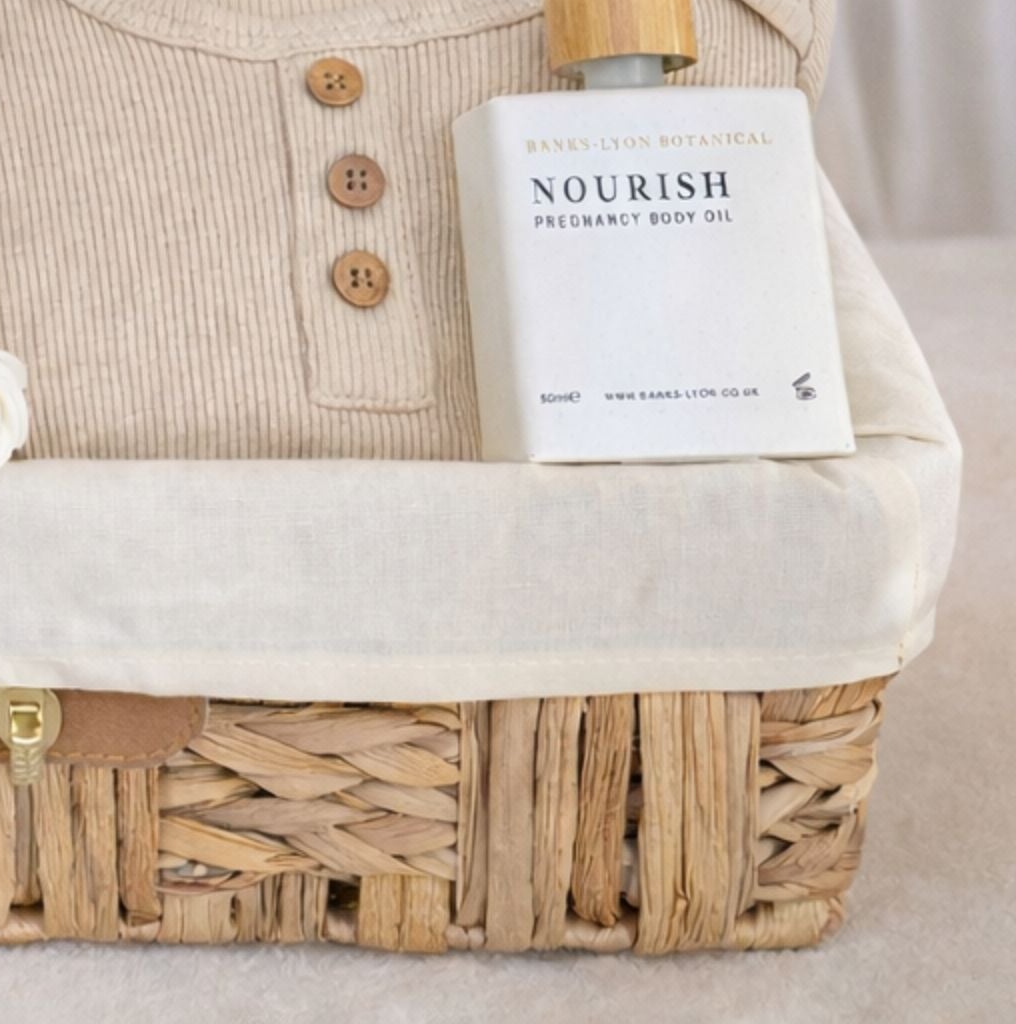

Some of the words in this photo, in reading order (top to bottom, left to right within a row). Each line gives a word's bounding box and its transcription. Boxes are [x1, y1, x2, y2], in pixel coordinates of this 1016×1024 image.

[658, 131, 773, 148] BOTANICAL
[530, 170, 731, 205] NOURISH
[648, 210, 696, 227] BODY
[703, 208, 733, 224] OIL
